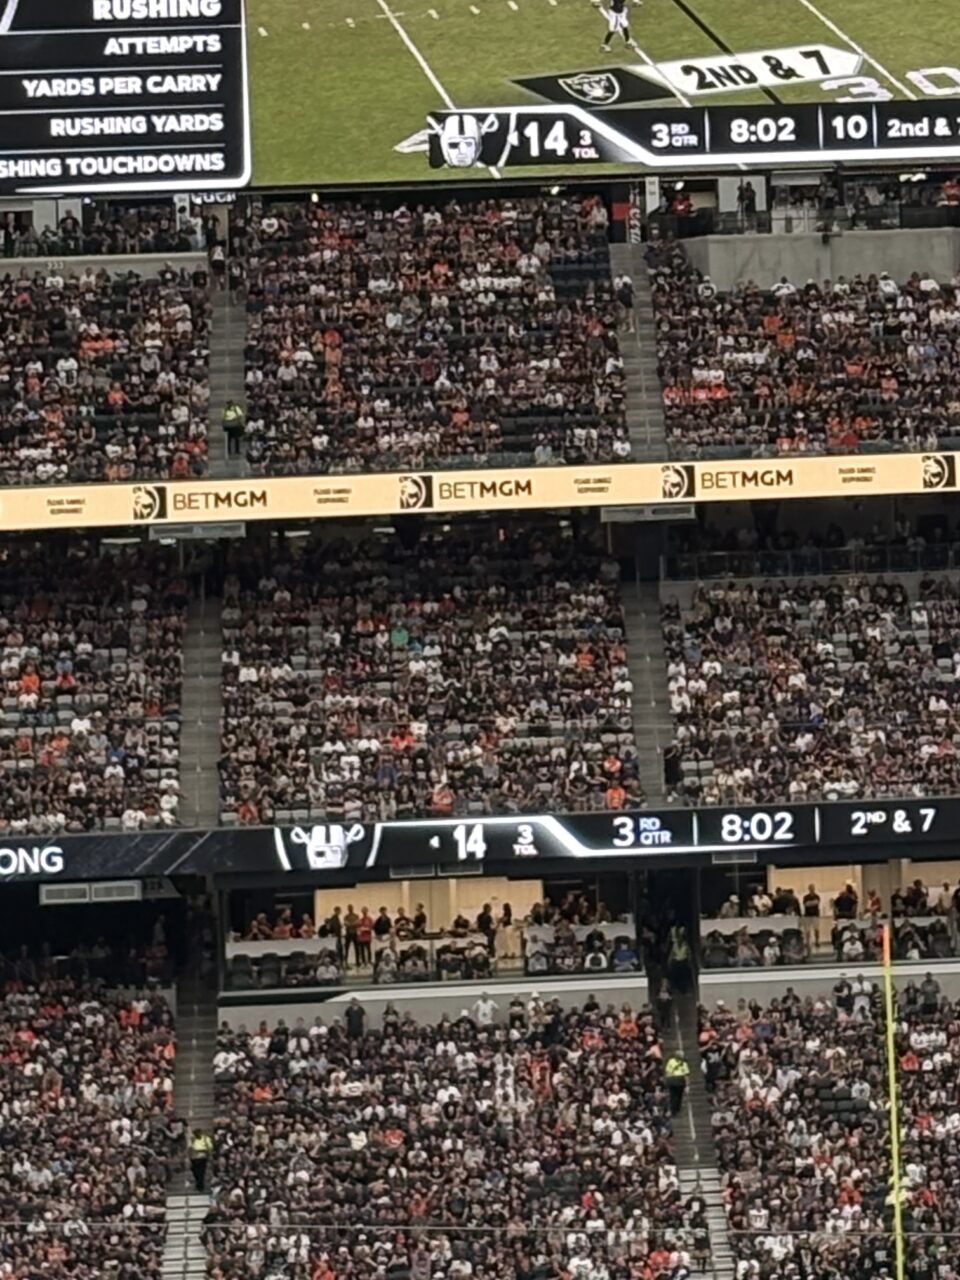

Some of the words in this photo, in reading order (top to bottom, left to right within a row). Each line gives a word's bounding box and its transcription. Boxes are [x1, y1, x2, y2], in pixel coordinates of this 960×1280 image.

[104, 36, 222, 56] ATTEMPTS
[681, 64, 759, 91] 2ND
[762, 55, 795, 78] &
[802, 50, 833, 76] 7
[23, 78, 94, 97] YARDS
[100, 76, 142, 95] PER
[147, 74, 222, 94] CARRY
[50, 116, 147, 137] RUSHING
[151, 113, 223, 133] YARDS
[729, 117, 796, 144] 8:02
[831, 115, 868, 139] 10
[886, 117, 929, 138] 2nd
[933, 118, 952, 136] &
[523, 120, 569, 157] 14
[579, 129, 591, 145] 3
[670, 135, 698, 148] QTR
[66, 153, 225, 175] TOUCHDOWNS
[439, 479, 533, 500] BETMGM
[701, 469, 793, 489] BETMGM
[173, 490, 268, 510] BETMGM
[721, 811, 795, 843] 8:02
[851, 811, 886, 835] 2ND
[892, 809, 912, 833] &
[921, 809, 936, 832] 7
[453, 824, 487, 860] 14
[517, 825, 534, 845] 3
[640, 830, 671, 845] QTR
[0, 846, 64, 875] ONG
